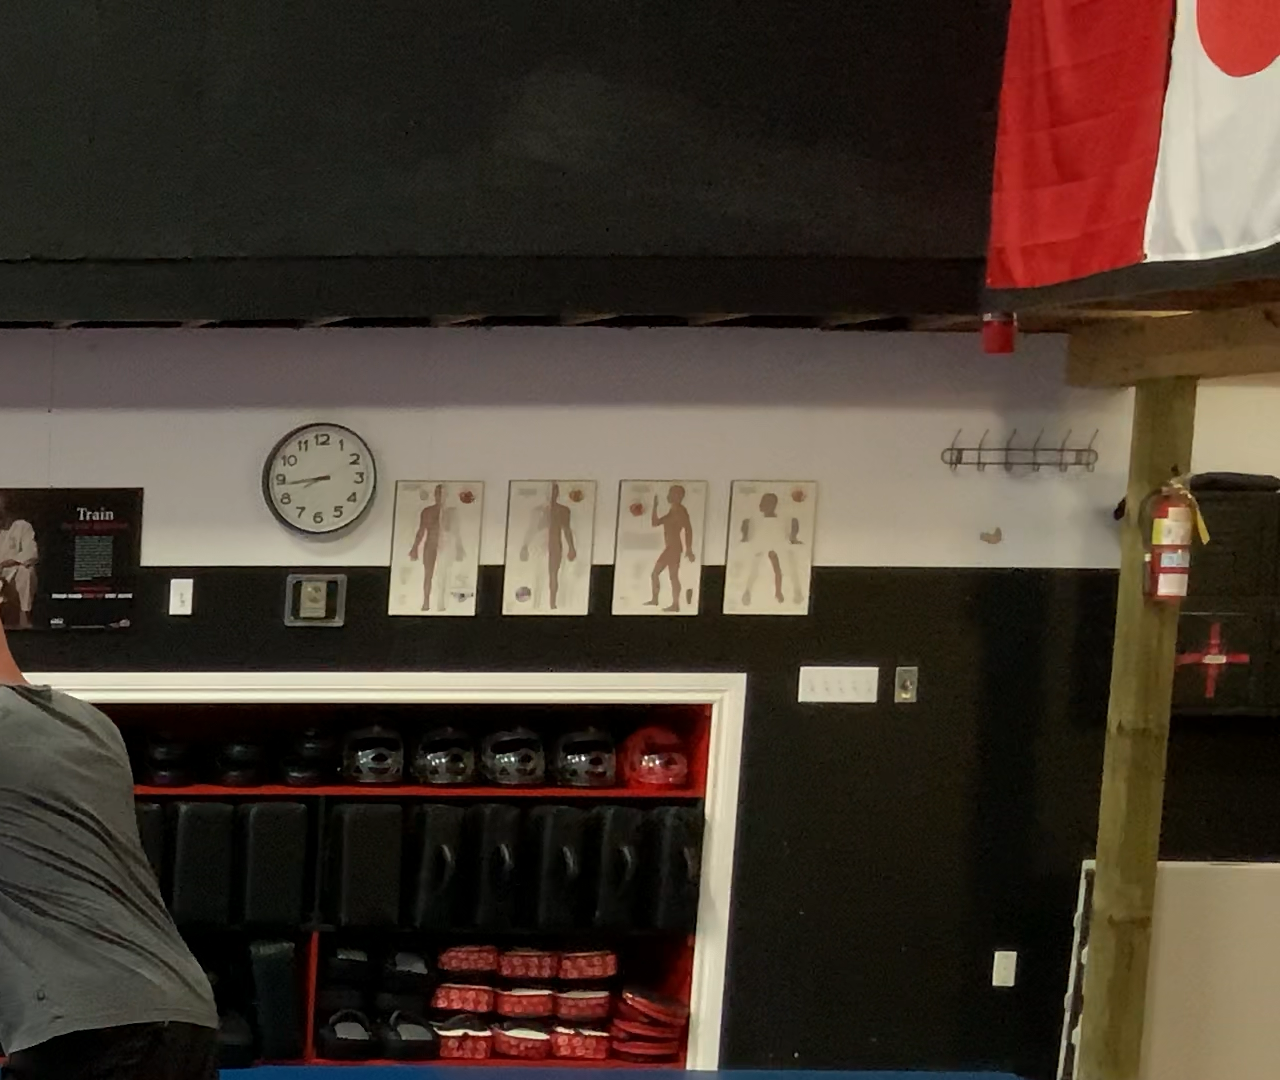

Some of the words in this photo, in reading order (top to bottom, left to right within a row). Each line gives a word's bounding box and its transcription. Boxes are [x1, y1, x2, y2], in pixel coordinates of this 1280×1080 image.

[297, 439, 309, 452] 11
[314, 433, 331, 446] 12
[338, 438, 344, 451] 1
[281, 454, 298, 467] 10
[349, 453, 360, 465] 2
[275, 473, 286, 486] 9
[353, 471, 364, 484] 3
[280, 492, 292, 505] 8
[346, 491, 357, 503] 4
[76, 506, 114, 521] Train
[295, 506, 306, 519] 7
[312, 511, 324, 524] 6
[332, 505, 344, 518] 5
